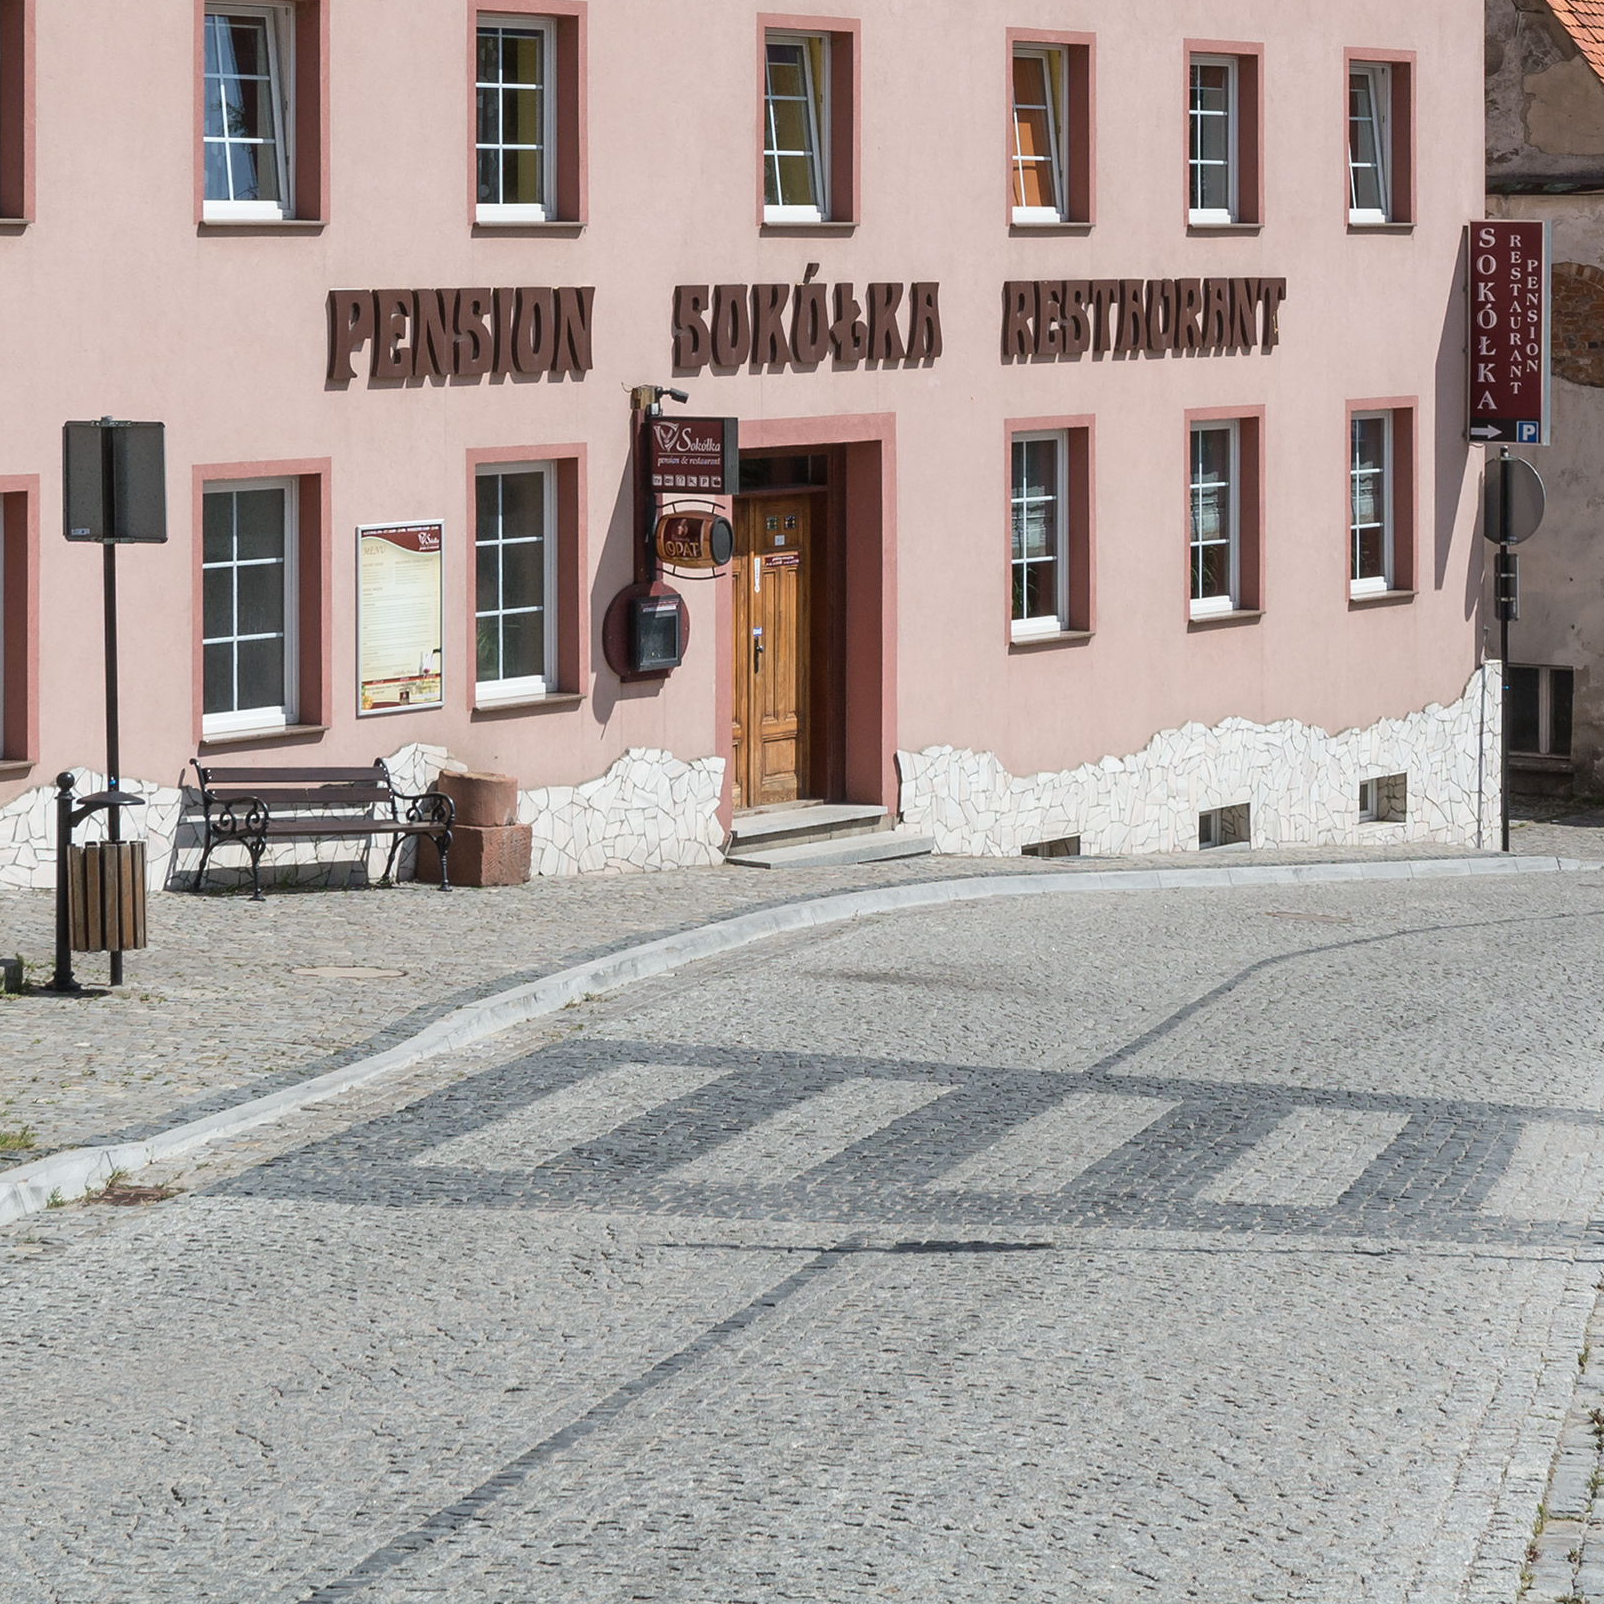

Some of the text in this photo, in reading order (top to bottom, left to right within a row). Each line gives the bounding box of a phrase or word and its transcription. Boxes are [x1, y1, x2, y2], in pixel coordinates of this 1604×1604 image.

[326, 263, 1287, 381] PENSION SOKÓŁKA RESTAURANT
[1476, 227, 1498, 410] SOKÓŁKA
[1509, 234, 1523, 395] RESTAURANT
[1525, 259, 1540, 373] PENSION
[657, 455, 680, 467] pension
[689, 457, 721, 465] restaurant
[676, 427, 721, 452] Sokółka
[1522, 424, 1536, 441] P
[665, 540, 699, 557] OPAT
